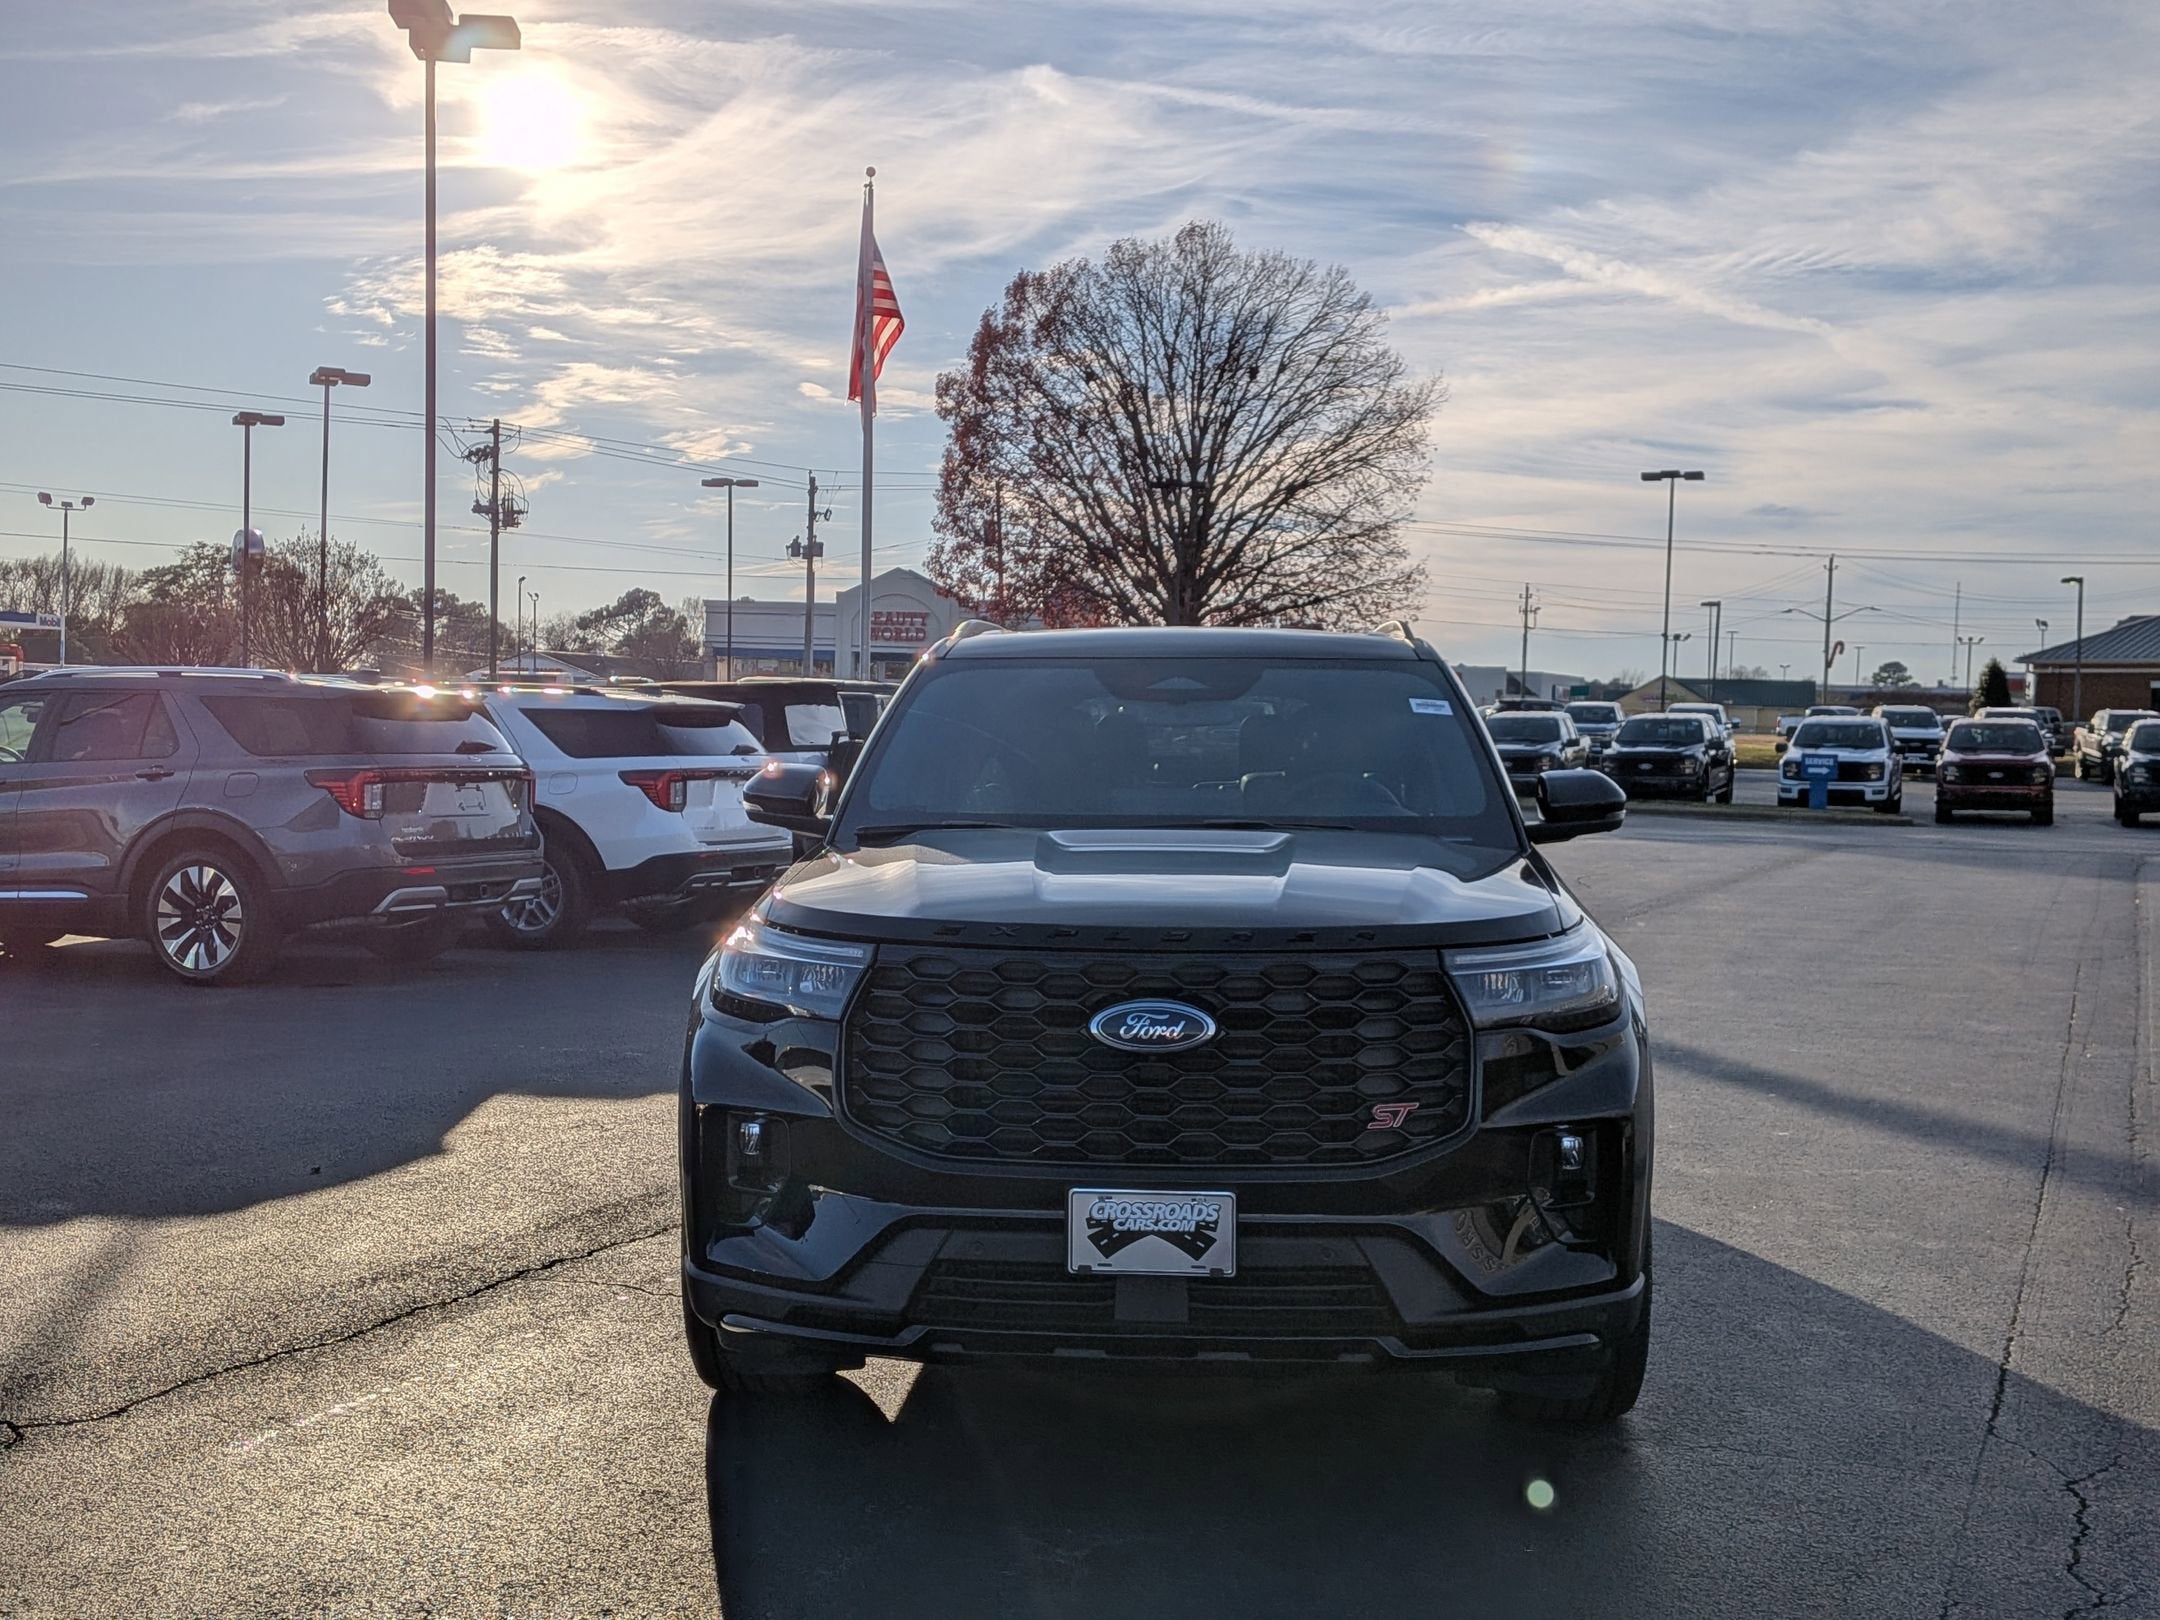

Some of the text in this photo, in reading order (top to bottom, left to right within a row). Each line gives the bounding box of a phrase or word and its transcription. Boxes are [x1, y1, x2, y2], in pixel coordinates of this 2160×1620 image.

[40, 616, 61, 627] Mobil
[871, 611, 930, 626] EAUTY
[1804, 757, 1834, 766] SERVICE
[933, 924, 1376, 942] EXPLORER
[1119, 1012, 1186, 1040] Ford
[1366, 1102, 1420, 1129] ST
[1089, 1201, 1222, 1222] CROSSROADS
[1112, 1217, 1197, 1233] CARS.COM
